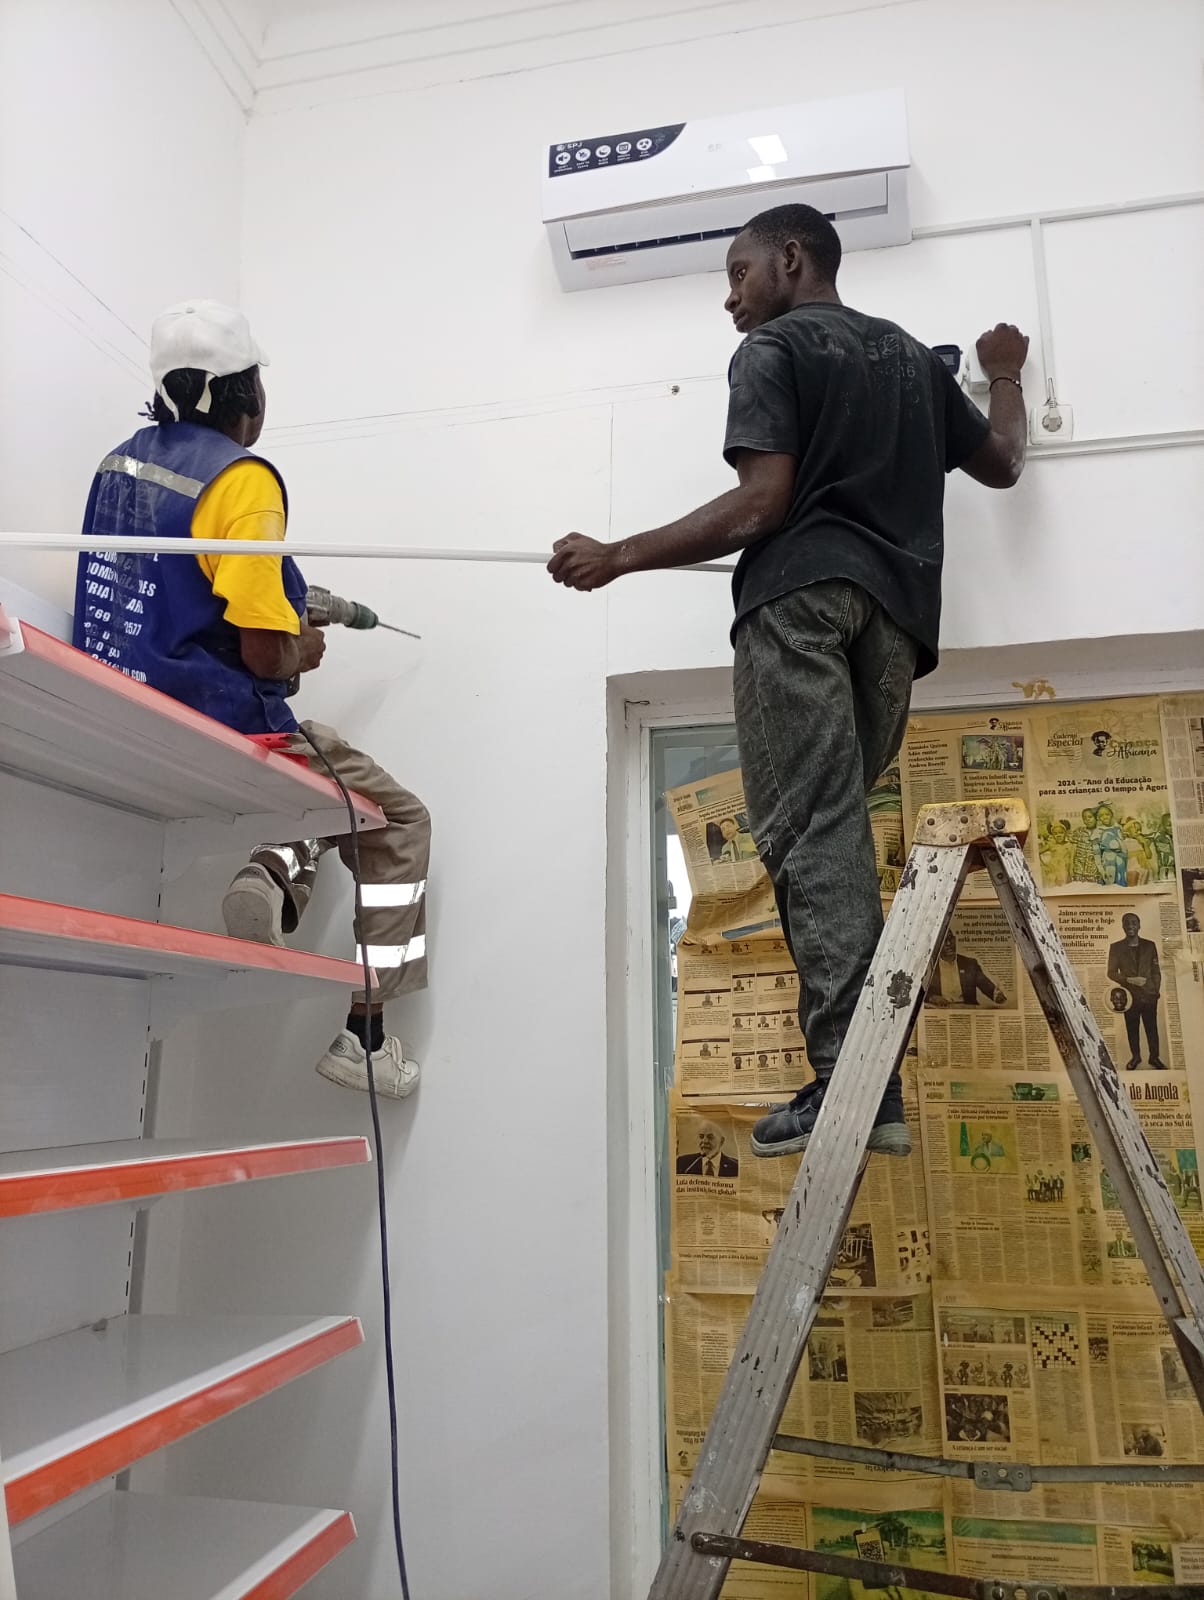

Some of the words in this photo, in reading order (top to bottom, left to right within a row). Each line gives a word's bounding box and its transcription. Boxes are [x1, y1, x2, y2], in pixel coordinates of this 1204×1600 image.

[567, 142, 583, 150] SPJ
[1047, 738, 1083, 748] Especial
[1110, 739, 1160, 749] Criança
[1107, 742, 1158, 759] Africana
[1116, 776, 1152, 785] Educação
[1039, 789, 1056, 797] para
[1068, 787, 1102, 795] crianças:
[1112, 785, 1137, 794] tempo
[1100, 917, 1115, 925] hoje
[1129, 1082, 1142, 1100] de
[1145, 1082, 1180, 1102] Angola
